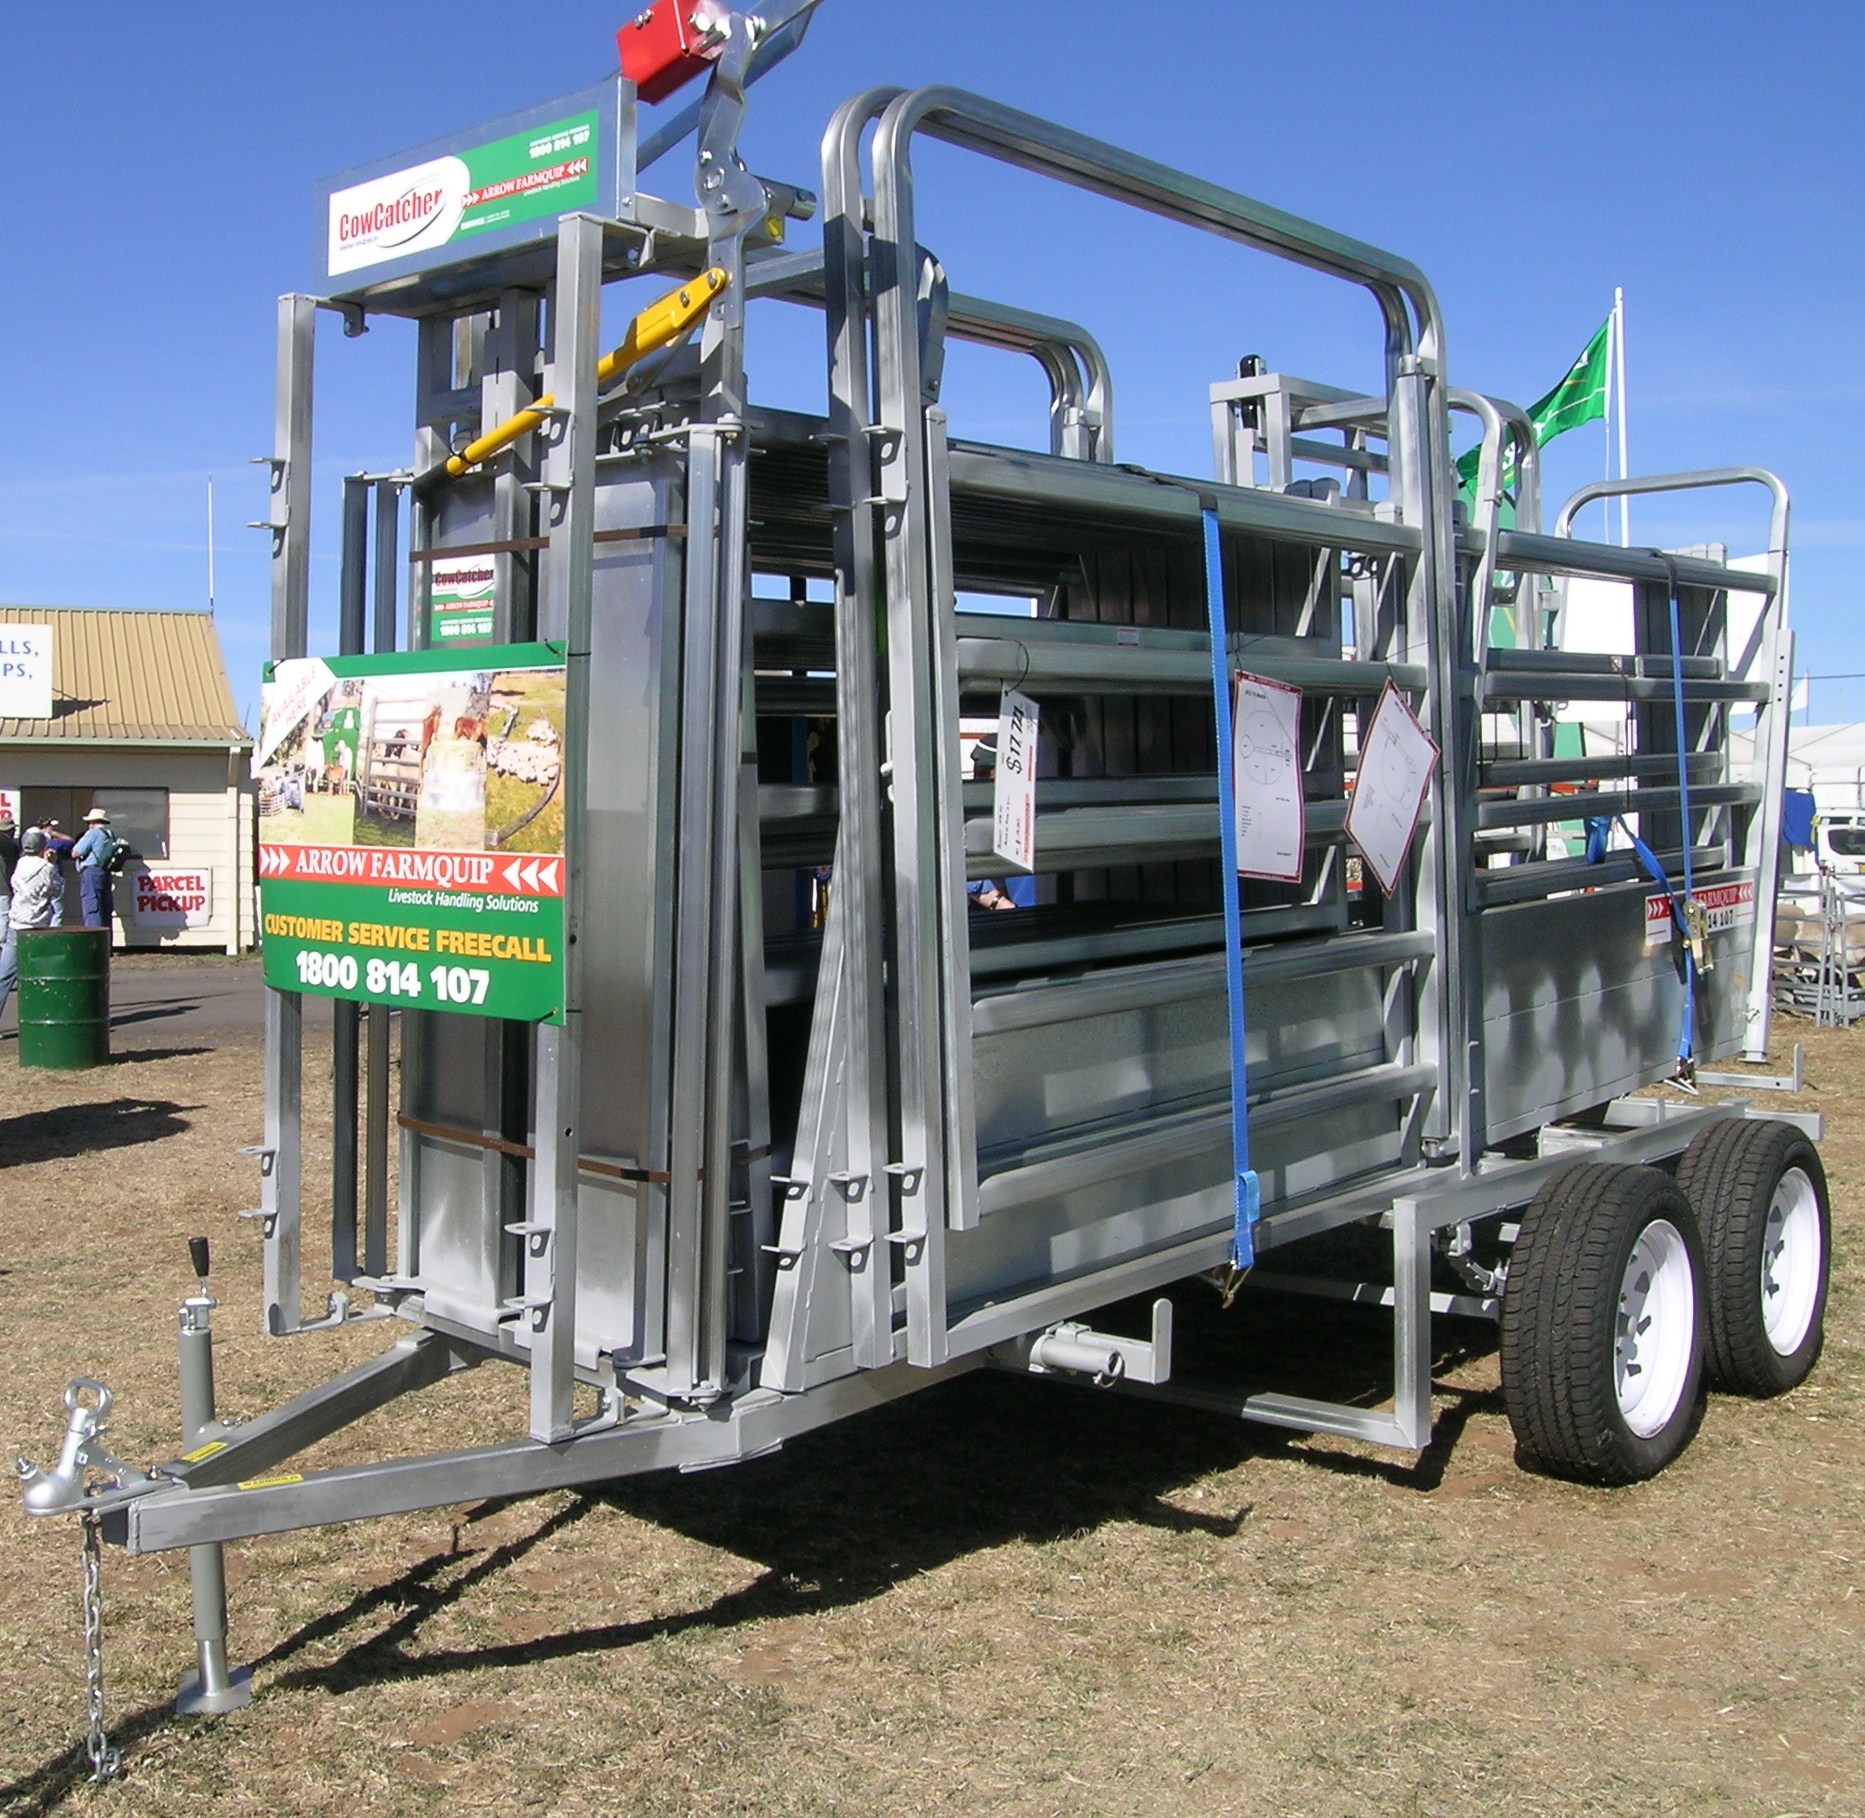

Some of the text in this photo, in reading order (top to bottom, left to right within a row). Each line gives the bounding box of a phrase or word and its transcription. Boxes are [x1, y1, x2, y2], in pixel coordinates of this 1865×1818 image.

[481, 180, 515, 200] ARROW
[516, 166, 565, 190] FARMQUIP
[340, 187, 443, 242] CowCatcher
[137, 876, 205, 891] PARCEL
[295, 849, 494, 888] ARROW FARMQUIP
[137, 895, 205, 912] PICKUP
[388, 888, 539, 912] Livestock Handling Solutions
[265, 914, 551, 962] CUSTOMER SERVICE FREECALL
[296, 950, 490, 1004] 1800 814 107
